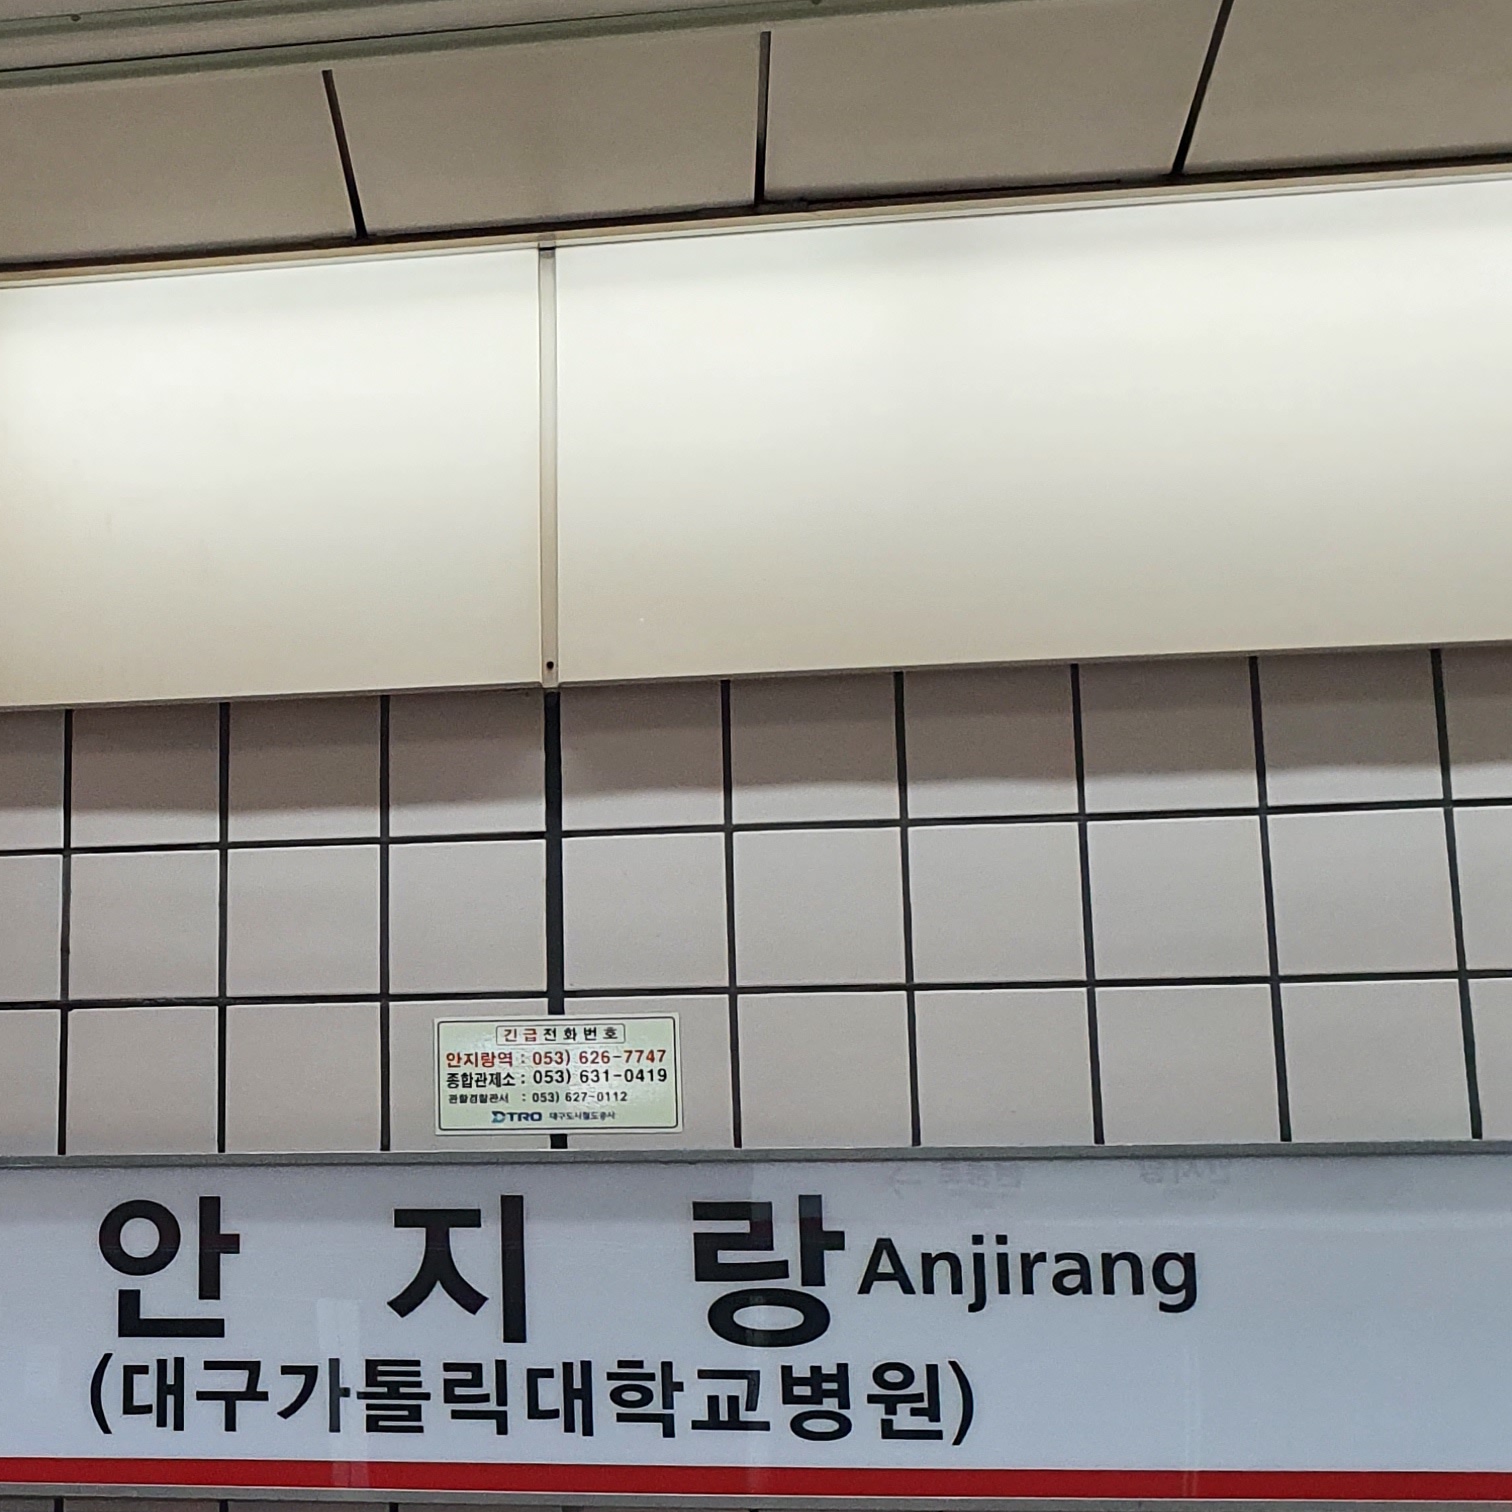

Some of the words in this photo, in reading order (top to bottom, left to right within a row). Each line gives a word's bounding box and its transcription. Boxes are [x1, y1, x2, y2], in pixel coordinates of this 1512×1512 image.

[445, 1052, 514, 1069] 안지랑역
[578, 1049, 667, 1065] 626-7747
[445, 1071, 516, 1089] 종합관제소
[579, 1068, 668, 1083] 631-0419
[564, 1091, 628, 1103] 627-0112
[857, 1234, 1198, 1314] Anjirang
[90, 1351, 974, 1446] (대구가톨릭대학교병원)
